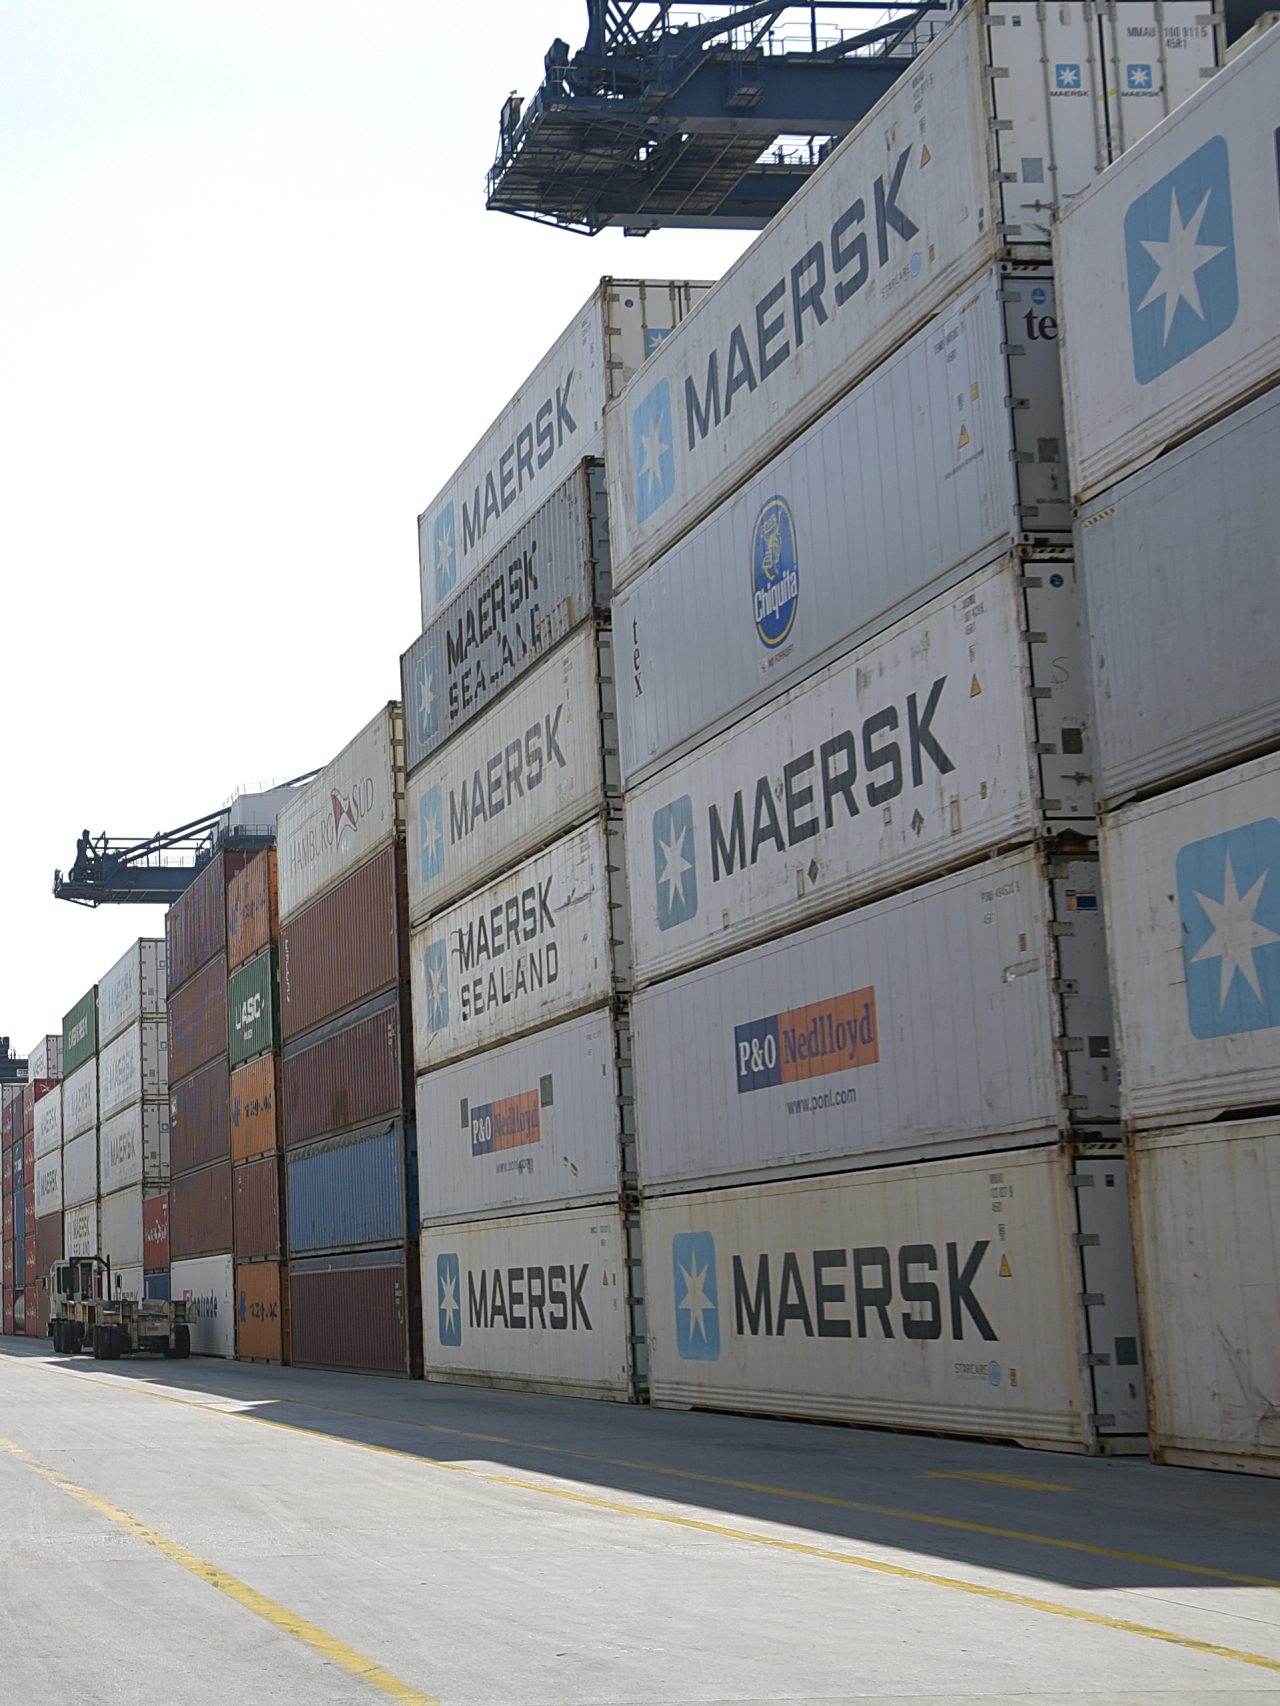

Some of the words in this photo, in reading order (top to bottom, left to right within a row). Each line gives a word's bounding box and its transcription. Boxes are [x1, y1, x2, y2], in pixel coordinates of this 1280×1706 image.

[684, 143, 920, 452] MAERSK
[461, 367, 578, 556] MAERSK
[447, 541, 538, 675] MAERSK
[754, 568, 798, 623] Chiquita
[632, 616, 643, 700] tex
[449, 703, 568, 846] MAERSK
[708, 675, 957, 883] MAERSK
[290, 812, 334, 879] HAMBURG
[352, 777, 374, 825] SÜD
[458, 874, 556, 974] MAERSK
[460, 941, 558, 1022] SEALAND
[738, 1033, 777, 1076] P&O
[783, 1002, 873, 1065] Nedlloyd
[472, 1115, 492, 1145] P&O
[494, 1104, 538, 1139] Nedlloyd
[786, 1088, 857, 1116] www.ponl.com
[468, 1262, 593, 1331] MAERSK
[732, 1240, 999, 1342] MAERSK
